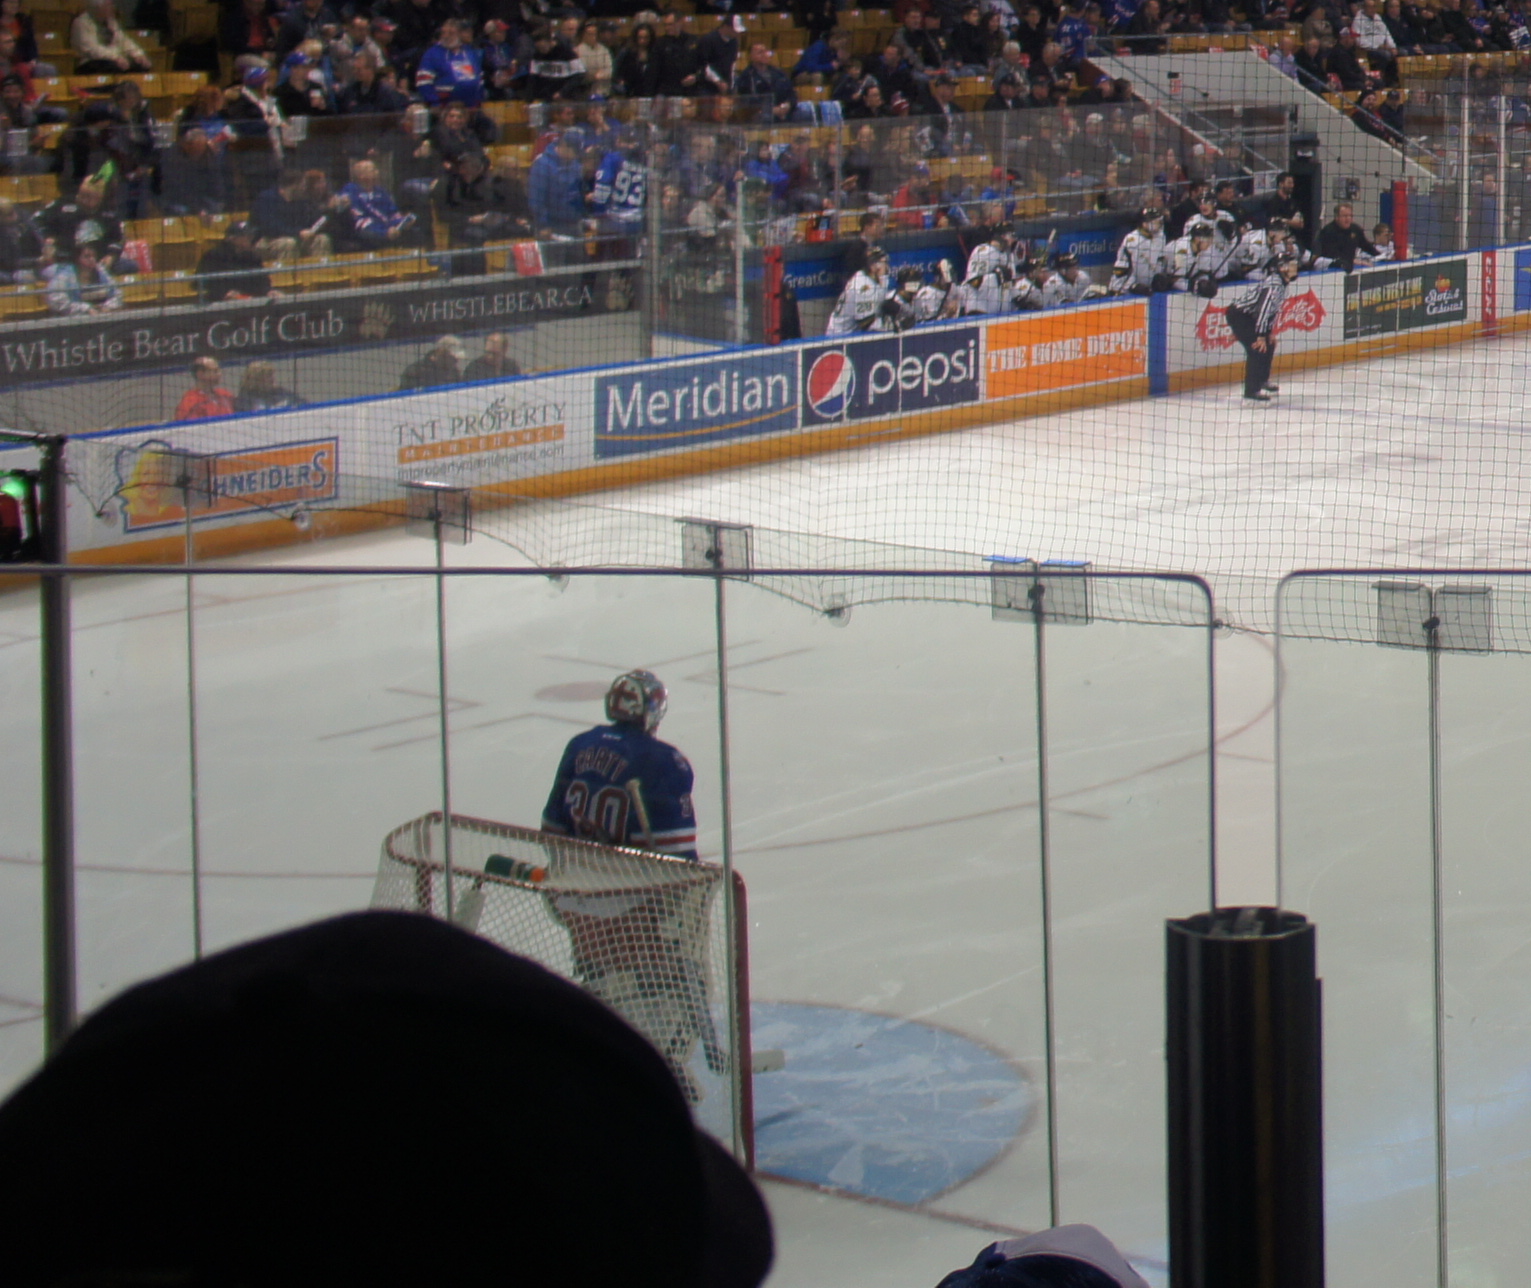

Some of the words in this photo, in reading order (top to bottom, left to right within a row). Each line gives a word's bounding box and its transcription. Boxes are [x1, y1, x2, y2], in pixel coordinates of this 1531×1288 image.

[410, 285, 593, 323] WHISTLEBEAR.CA
[2, 332, 123, 373] Whistle
[133, 328, 199, 360] Bear
[207, 314, 270, 350] Golf
[277, 309, 344, 343] Club
[988, 345, 1026, 373] THE
[1032, 337, 1083, 367] HOME
[1087, 327, 1144, 358] DEPOT
[868, 339, 977, 404] pepsi
[393, 420, 439, 446] TNT
[451, 401, 567, 437] PROPERTY
[606, 369, 789, 432] Meridian
